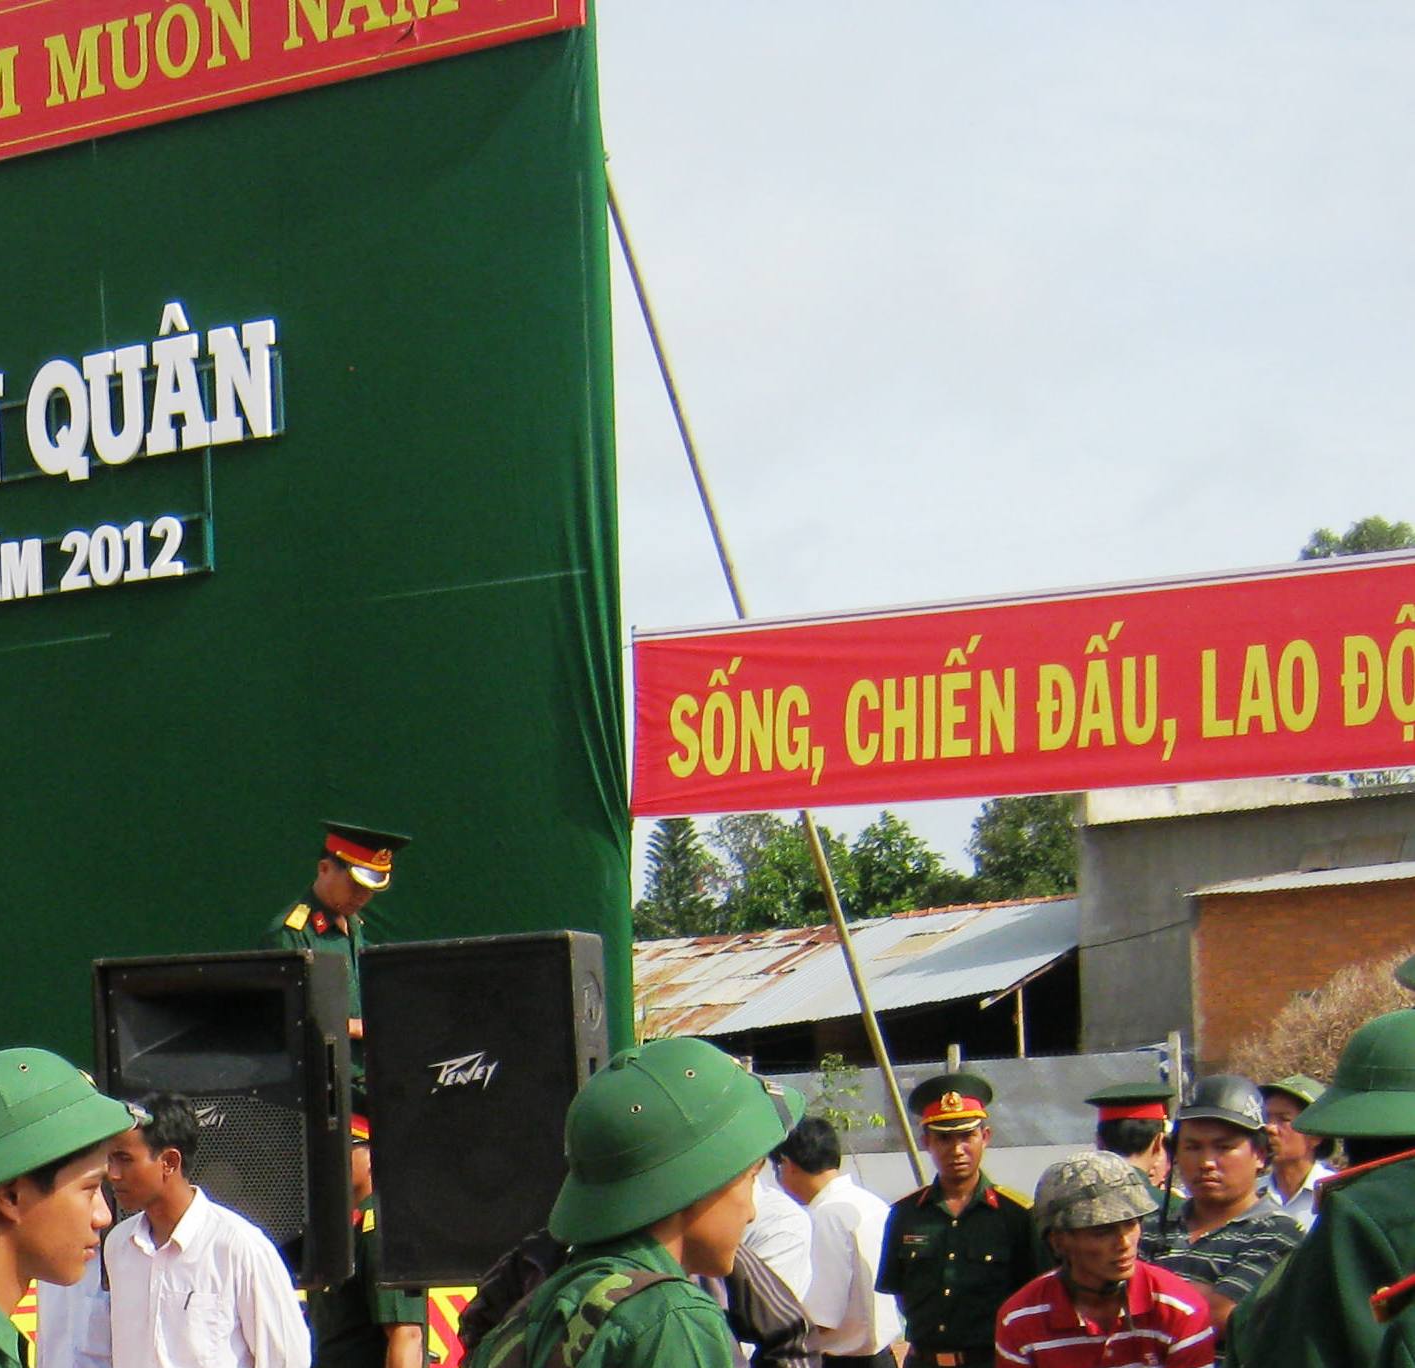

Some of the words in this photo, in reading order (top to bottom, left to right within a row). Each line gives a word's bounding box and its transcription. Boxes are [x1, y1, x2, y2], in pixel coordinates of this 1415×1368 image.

[26, 302, 277, 482] QUÂN
[60, 517, 185, 593] 2012
[667, 656, 826, 786] SỐNG,
[844, 635, 1016, 767] CHIẾN
[1036, 621, 1179, 762] ĐẤU,
[1201, 640, 1320, 738] LAO
